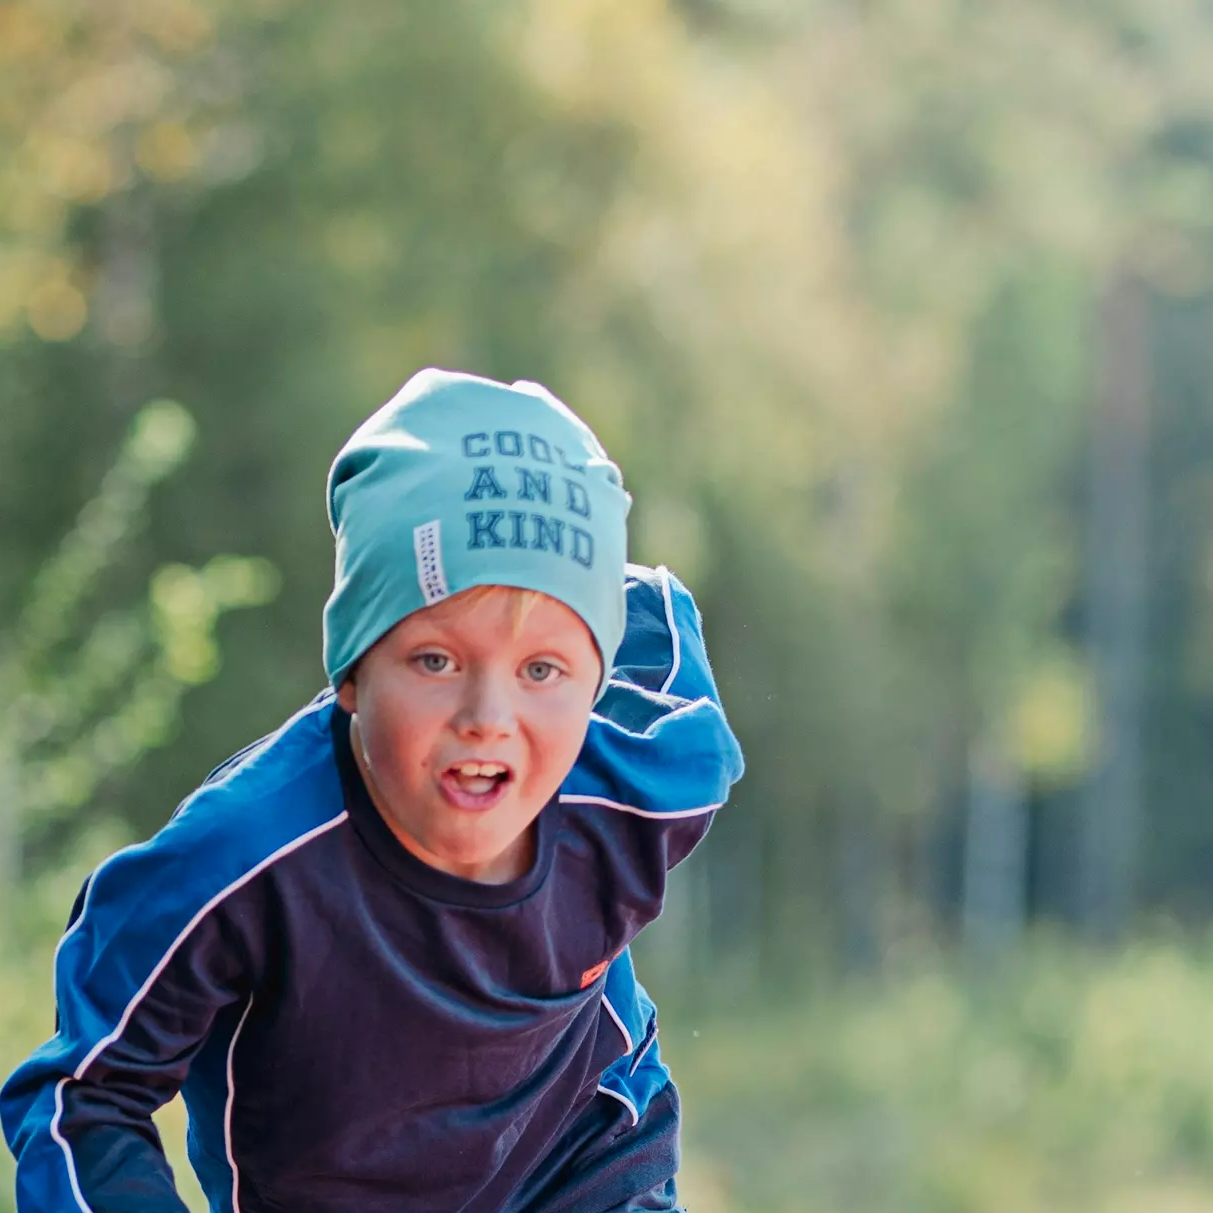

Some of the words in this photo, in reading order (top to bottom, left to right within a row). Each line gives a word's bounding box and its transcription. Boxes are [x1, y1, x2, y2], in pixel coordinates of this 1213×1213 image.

[461, 430, 586, 475] COOL
[464, 466, 592, 521] AND
[465, 510, 595, 571] KIND
